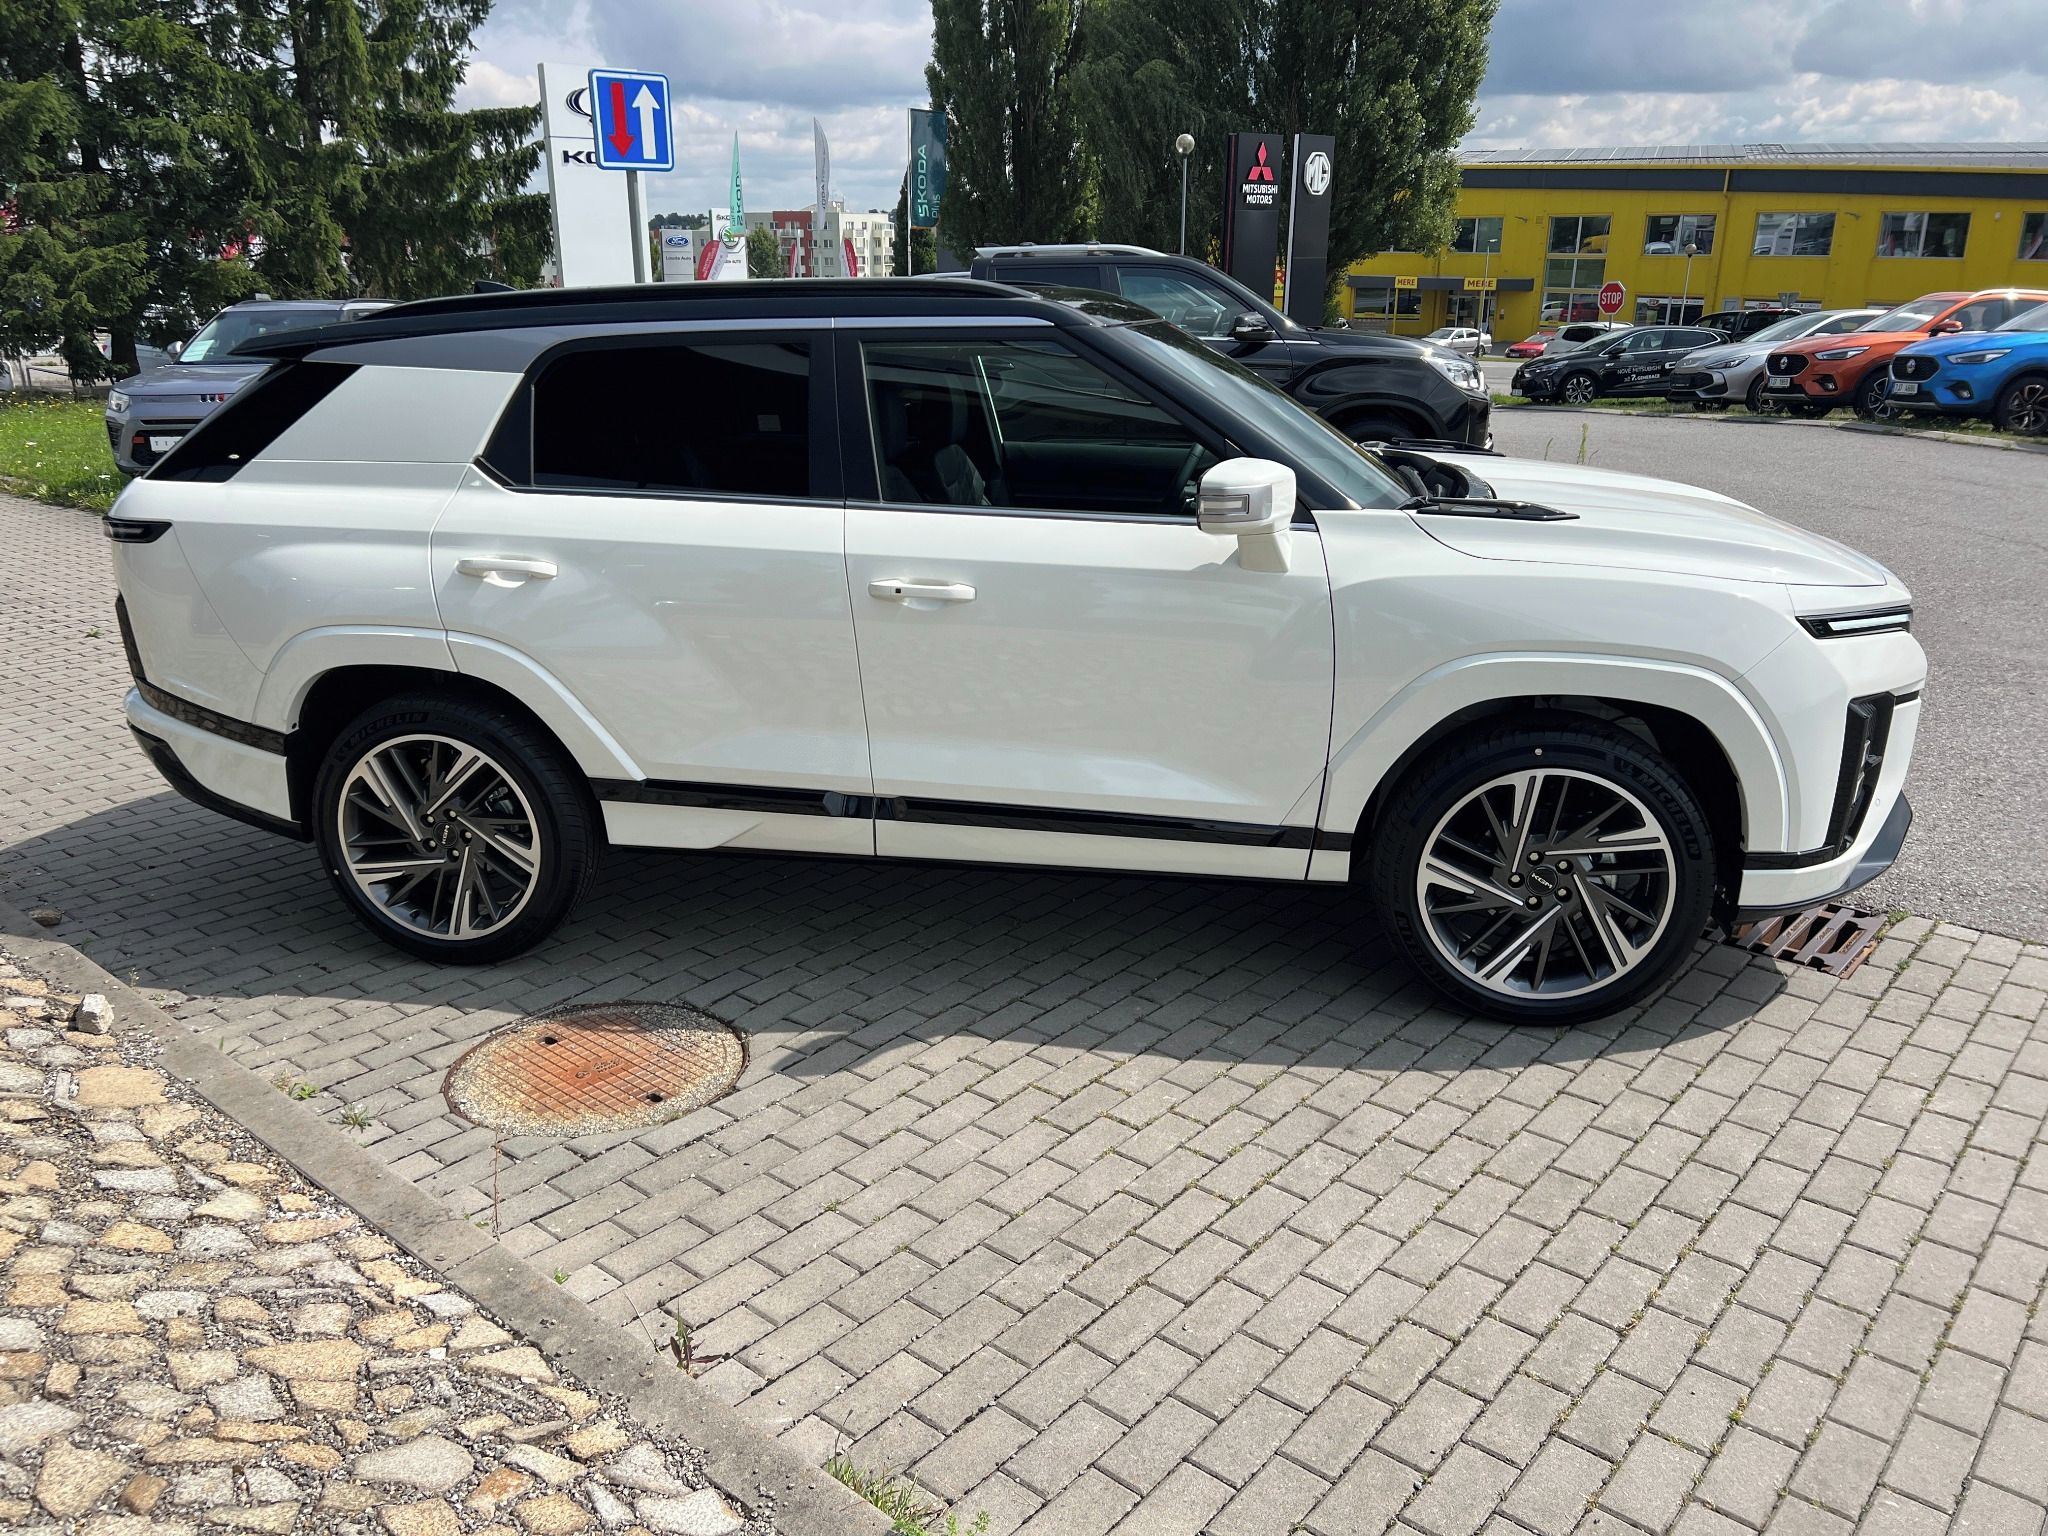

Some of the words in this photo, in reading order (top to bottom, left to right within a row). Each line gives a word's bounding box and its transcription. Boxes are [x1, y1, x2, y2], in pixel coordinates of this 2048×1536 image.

[1306, 154, 1330, 193] MG
[1242, 183, 1278, 194] MITSUBISHI
[1246, 195, 1273, 205] MOTORS
[670, 235, 687, 246] Ford
[1467, 279, 1494, 288] MERE
[1601, 292, 1622, 305] STOP
